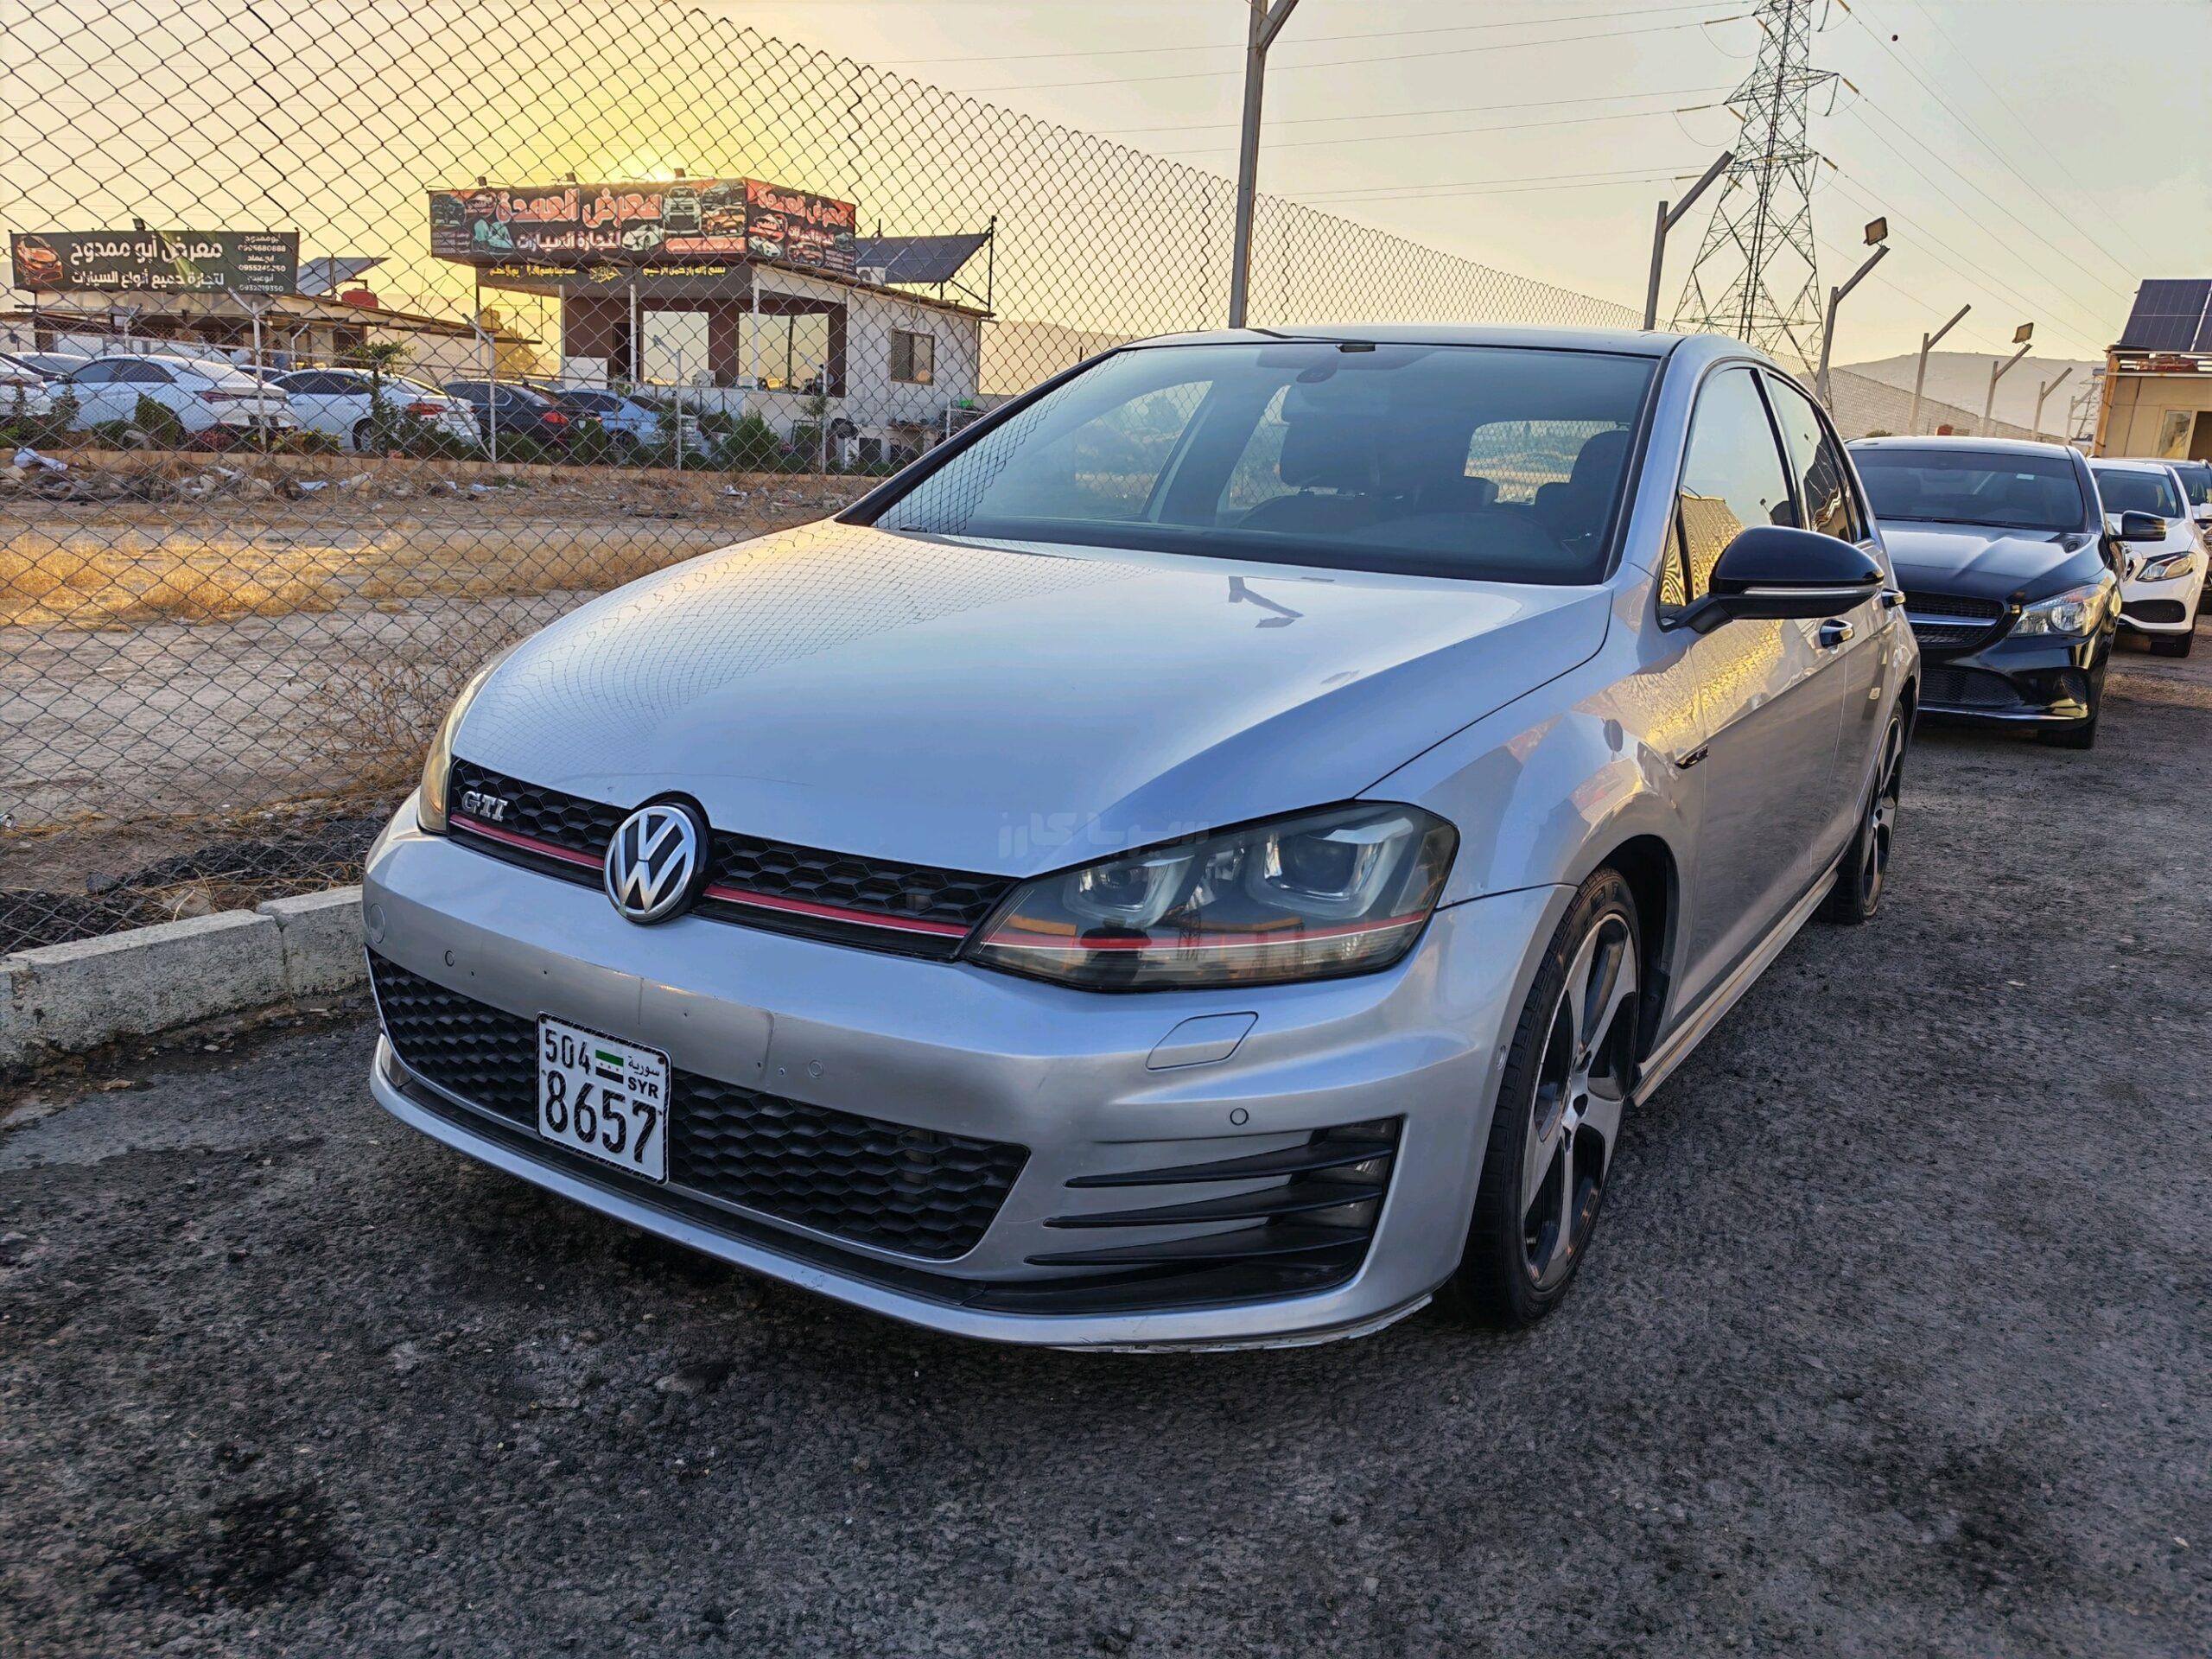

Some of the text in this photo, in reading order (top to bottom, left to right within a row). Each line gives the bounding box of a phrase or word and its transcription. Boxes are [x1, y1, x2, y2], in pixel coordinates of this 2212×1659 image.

[582, 188, 663, 229] معرض
[70, 234, 223, 265] معرض أبو ممدوح
[517, 231, 575, 252] السيارات
[71, 269, 225, 289] لتجارة جميع أنواع السيارات
[461, 790, 509, 823] GTI
[544, 1027, 592, 1077] 504
[627, 1054, 660, 1078] سورية
[627, 1077, 659, 1099] SYR
[545, 1069, 658, 1164] 8657
